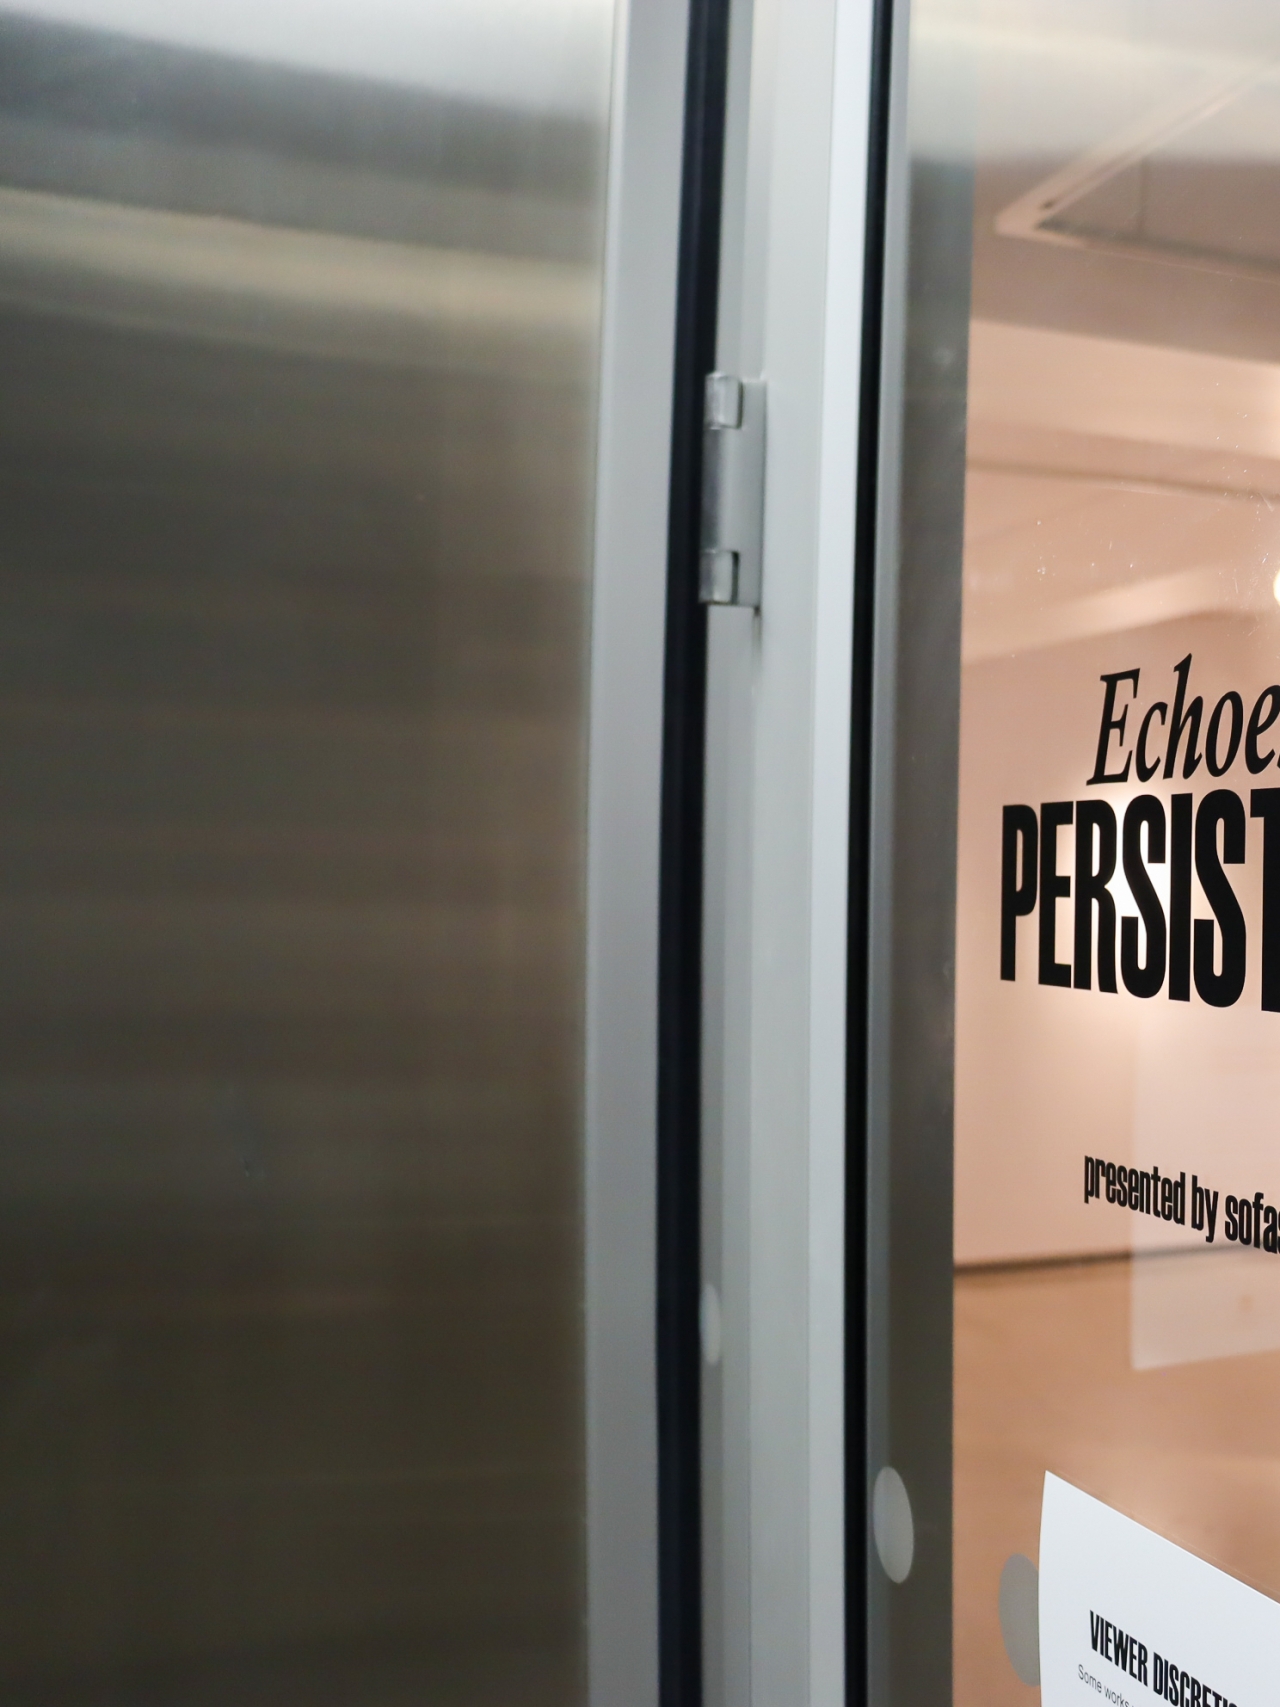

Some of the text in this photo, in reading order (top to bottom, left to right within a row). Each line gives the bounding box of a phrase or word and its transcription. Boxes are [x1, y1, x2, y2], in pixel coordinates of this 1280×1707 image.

[1084, 1155, 1186, 1225] presented
[1191, 1174, 1219, 1243] by
[1077, 1663, 1102, 1694] Some
[1089, 1610, 1238, 1707] VIEWER DISCRE
